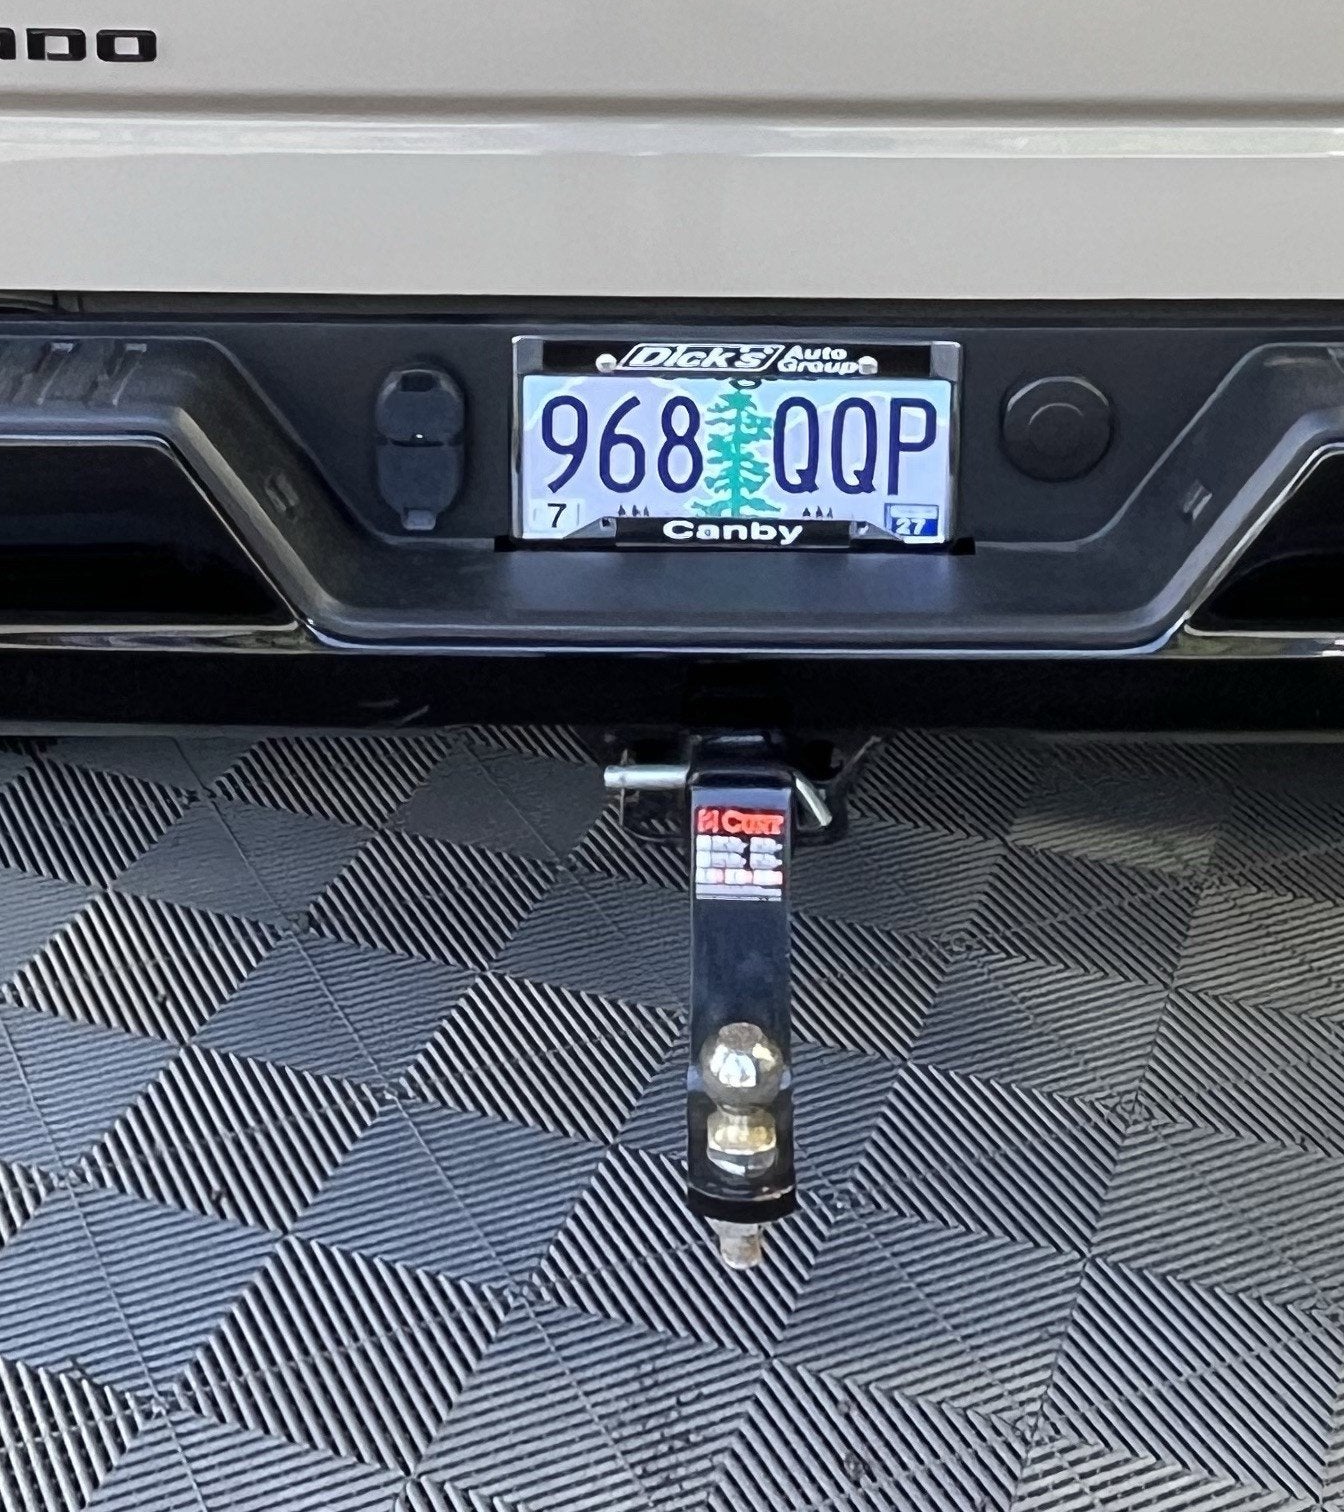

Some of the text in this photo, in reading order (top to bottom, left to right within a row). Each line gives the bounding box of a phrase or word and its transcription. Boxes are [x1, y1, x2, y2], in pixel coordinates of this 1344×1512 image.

[784, 345, 848, 360] Auto
[777, 358, 860, 375] Group
[541, 395, 937, 496] 968 QQP
[547, 502, 567, 528] 7
[662, 519, 804, 545] Canby
[896, 517, 927, 536] 27
